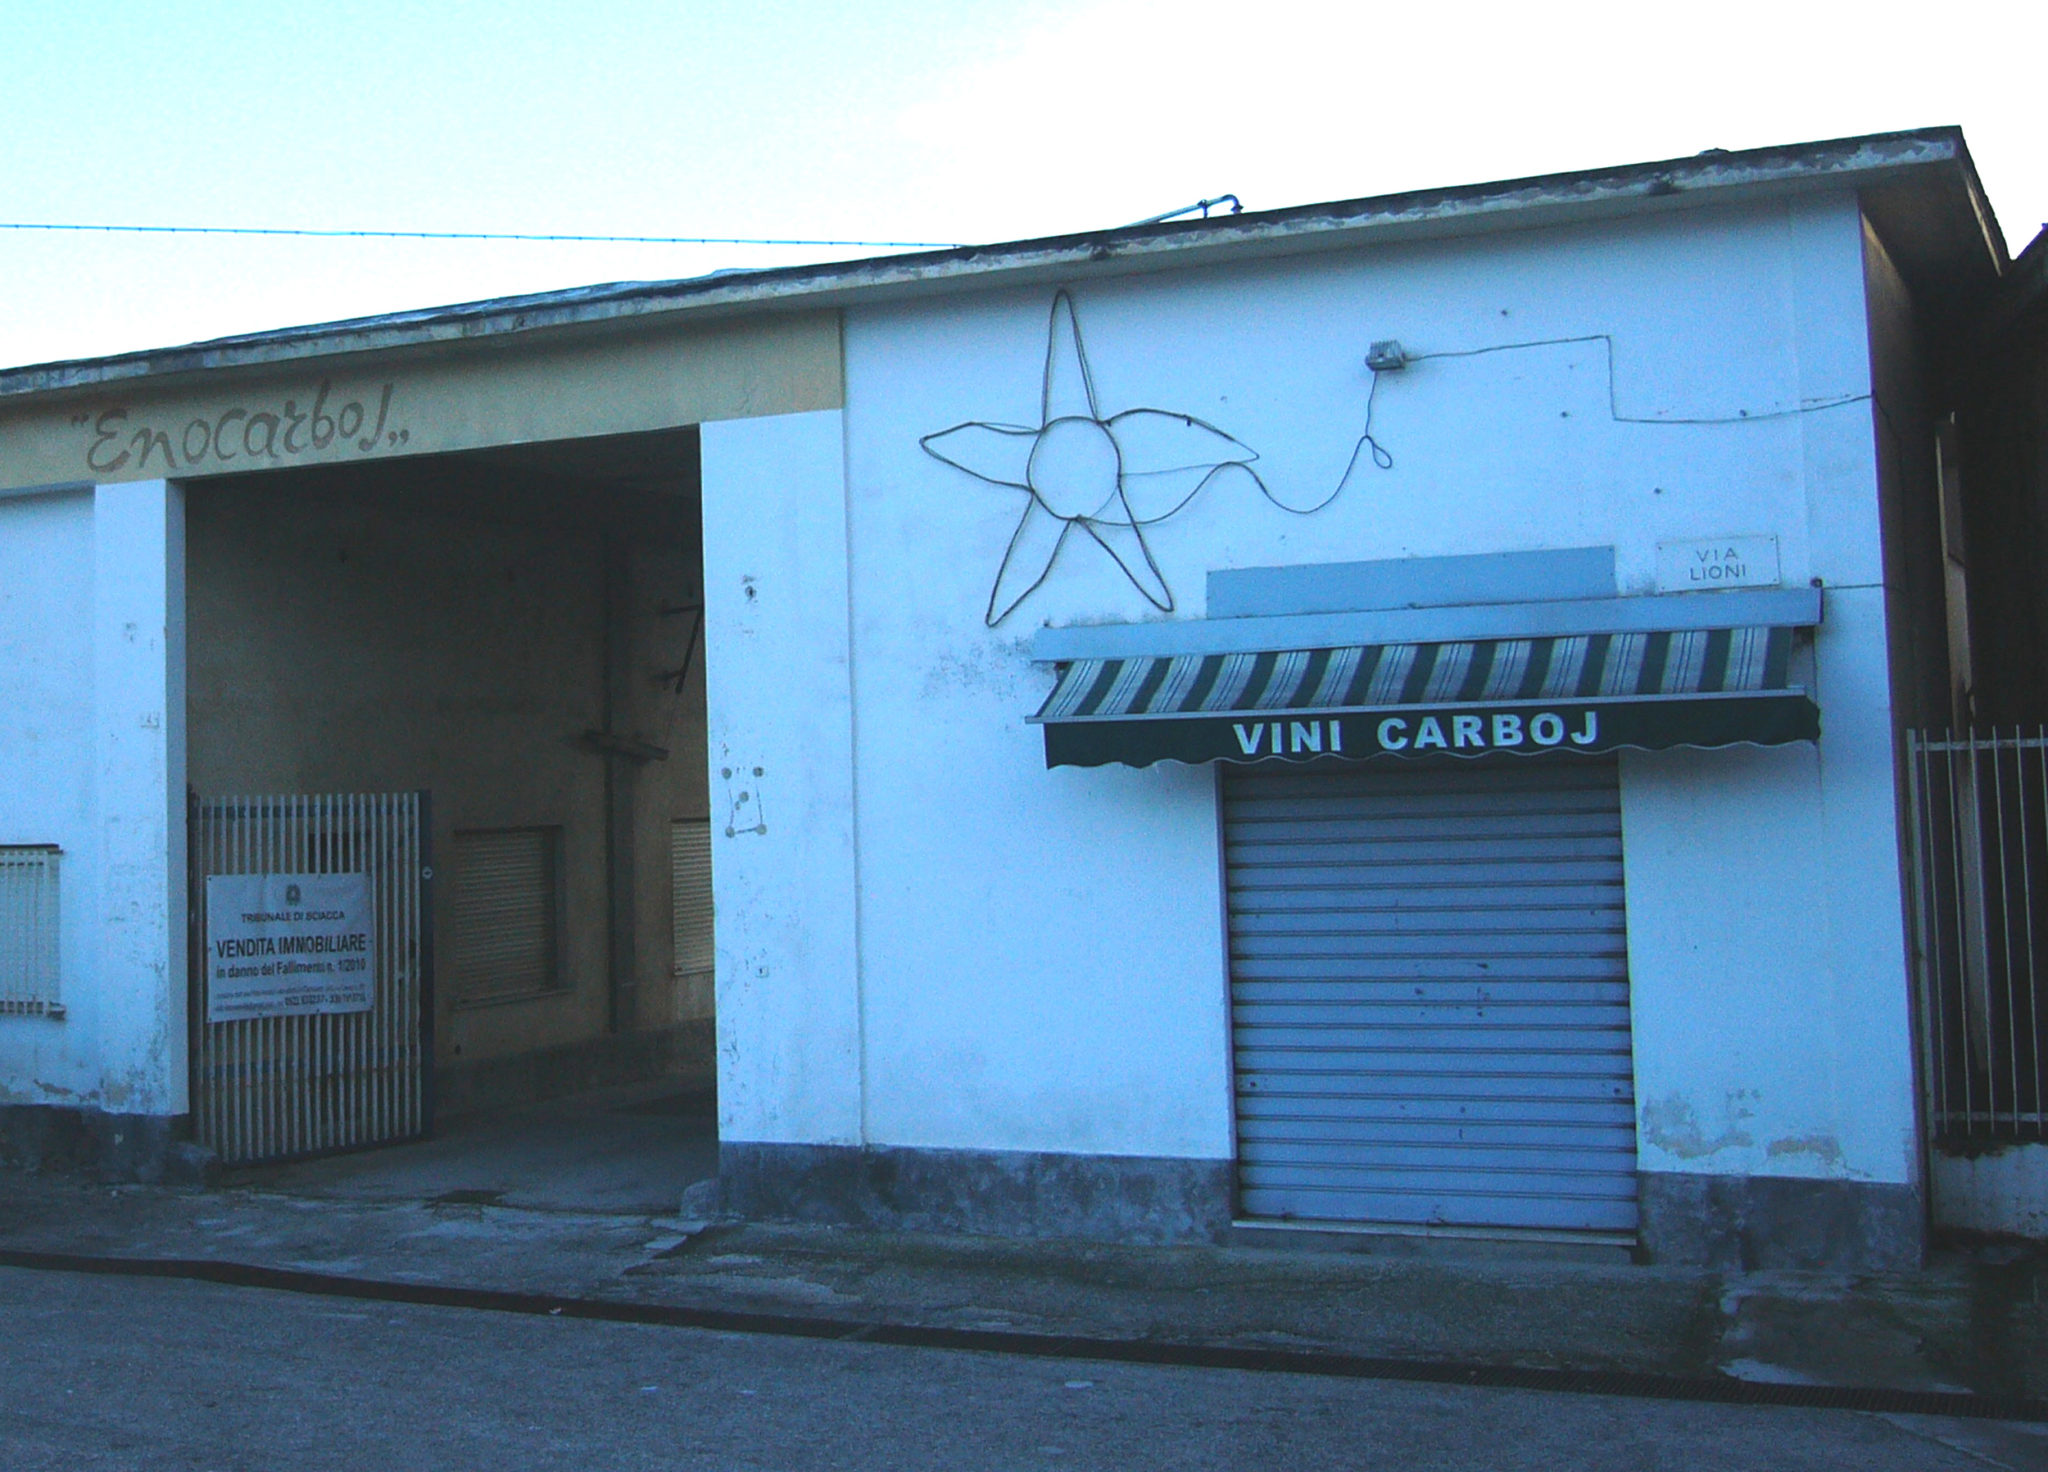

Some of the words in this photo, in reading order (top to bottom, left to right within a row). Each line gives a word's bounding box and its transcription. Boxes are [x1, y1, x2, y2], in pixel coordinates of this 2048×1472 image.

[1696, 547, 1738, 562] VIA
[1690, 564, 1746, 581] LIONI
[1233, 720, 1342, 755] VINI
[1377, 711, 1598, 751] CARBOJ
[241, 913, 291, 923] TRIBUNALE
[293, 911, 304, 921] DI
[306, 910, 346, 921] SCIACCA
[216, 937, 276, 958] VENDITA
[278, 933, 367, 954] IMMOBILIARE
[216, 965, 226, 979] in
[228, 964, 259, 978] danno
[260, 962, 275, 976] del
